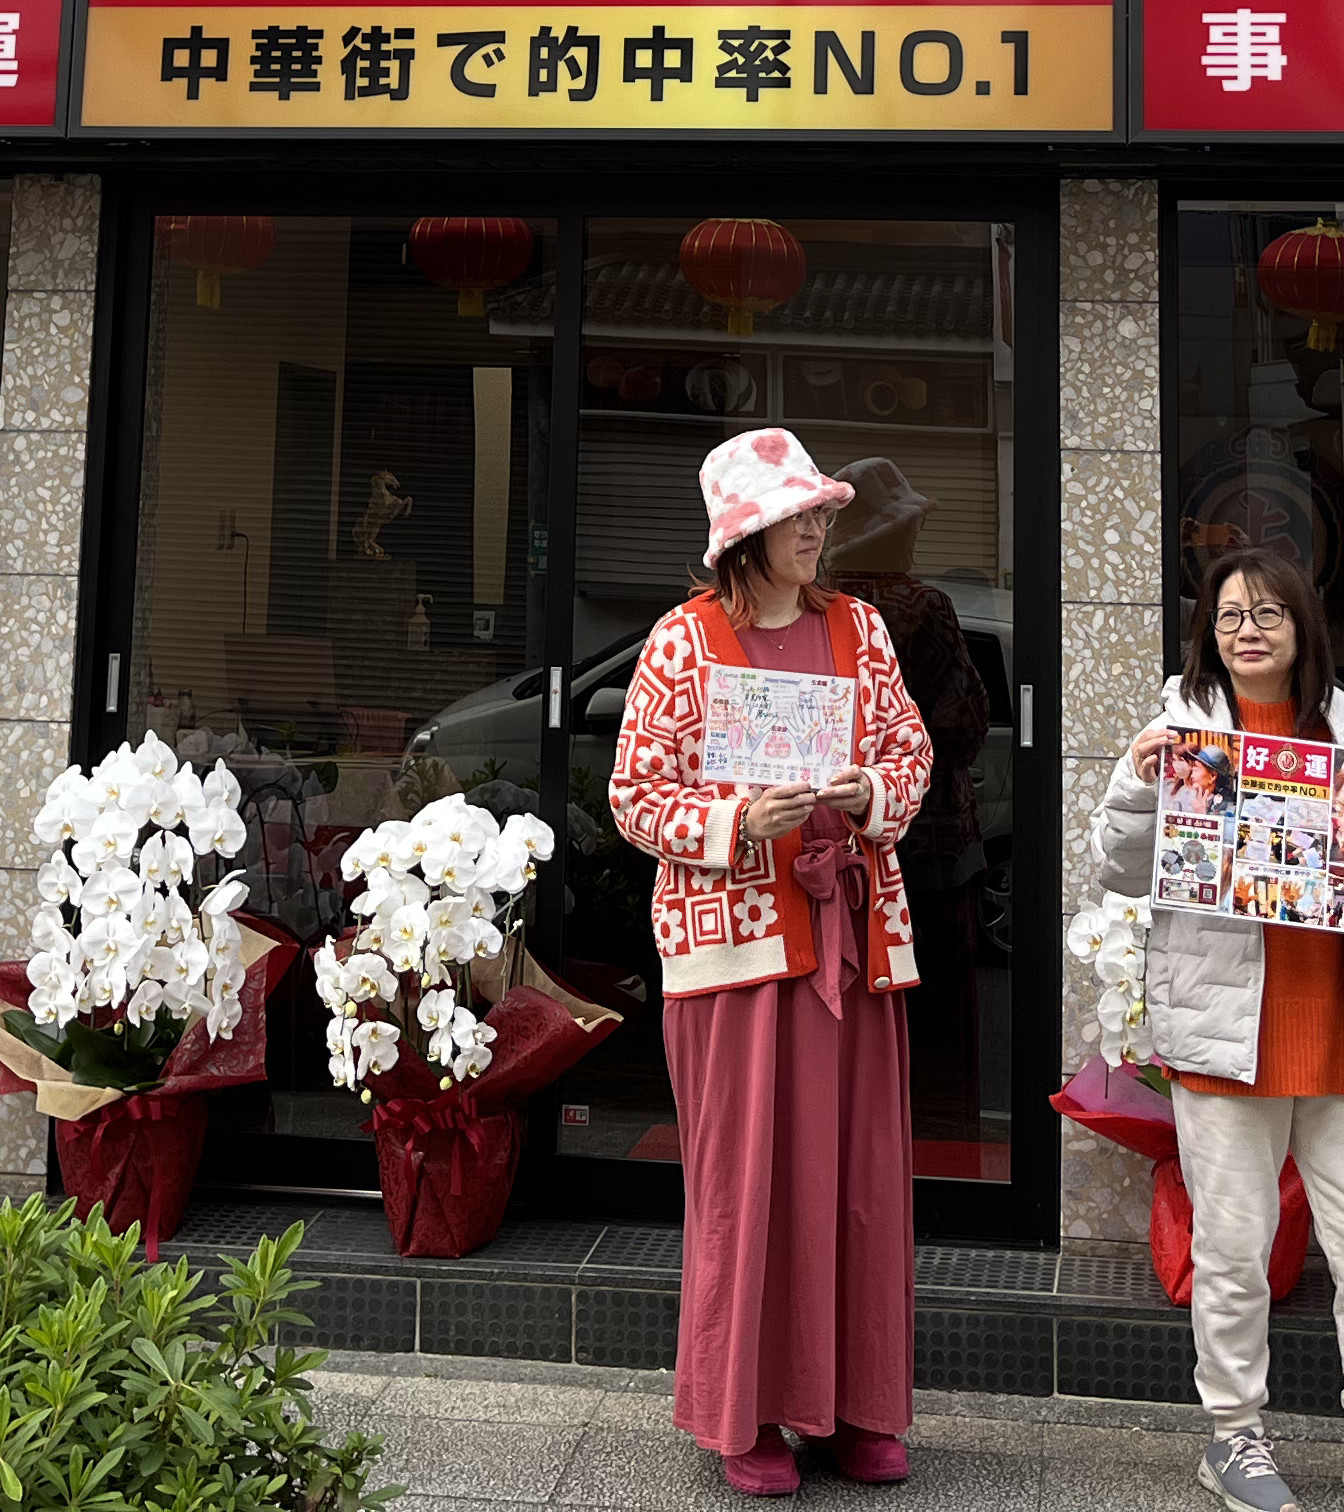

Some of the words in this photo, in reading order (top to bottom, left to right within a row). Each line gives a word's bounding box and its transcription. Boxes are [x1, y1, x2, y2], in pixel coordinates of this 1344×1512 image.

[158, 22, 1031, 104] 中華街で的中率NO.1
